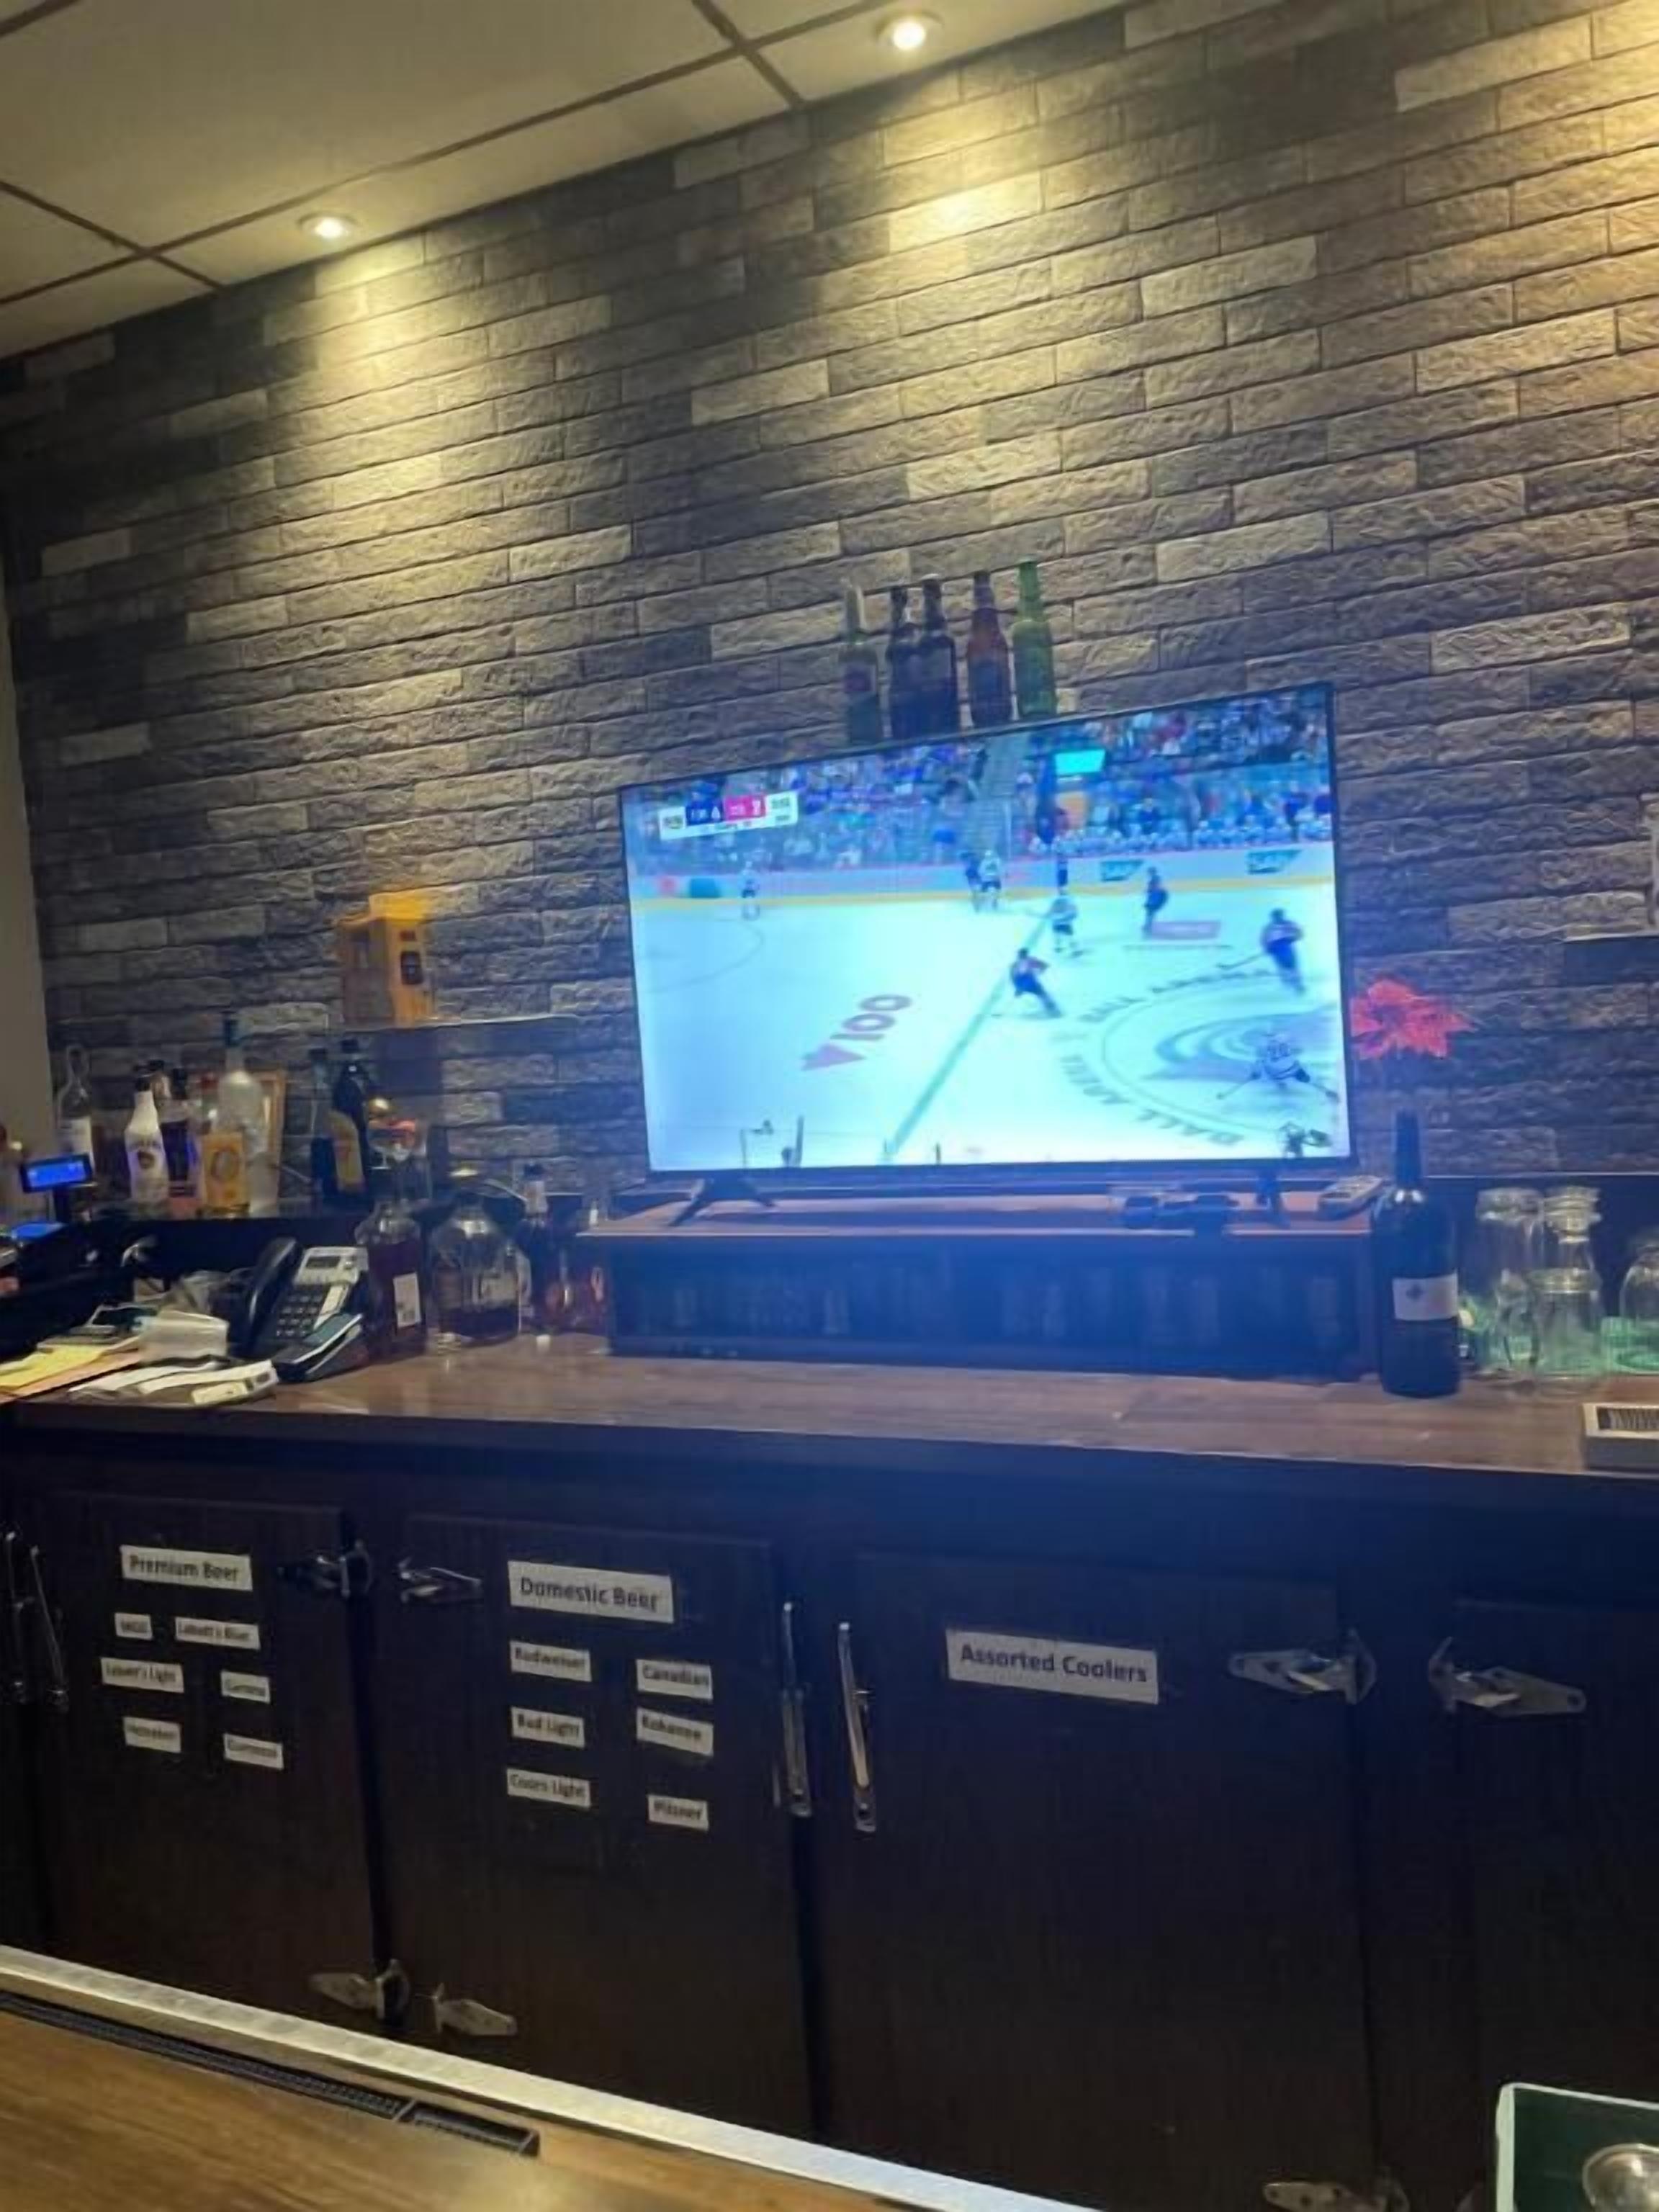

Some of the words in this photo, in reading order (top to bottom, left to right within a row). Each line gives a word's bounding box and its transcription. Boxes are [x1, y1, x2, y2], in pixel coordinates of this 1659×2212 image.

[130, 1555, 198, 1577] Premium
[203, 1561, 238, 1582] Beer
[520, 1578, 608, 1604] Domestic
[613, 1587, 658, 1612] Beer
[961, 1644, 1054, 1672] Assorted
[1063, 1656, 1146, 1682] Coolers
